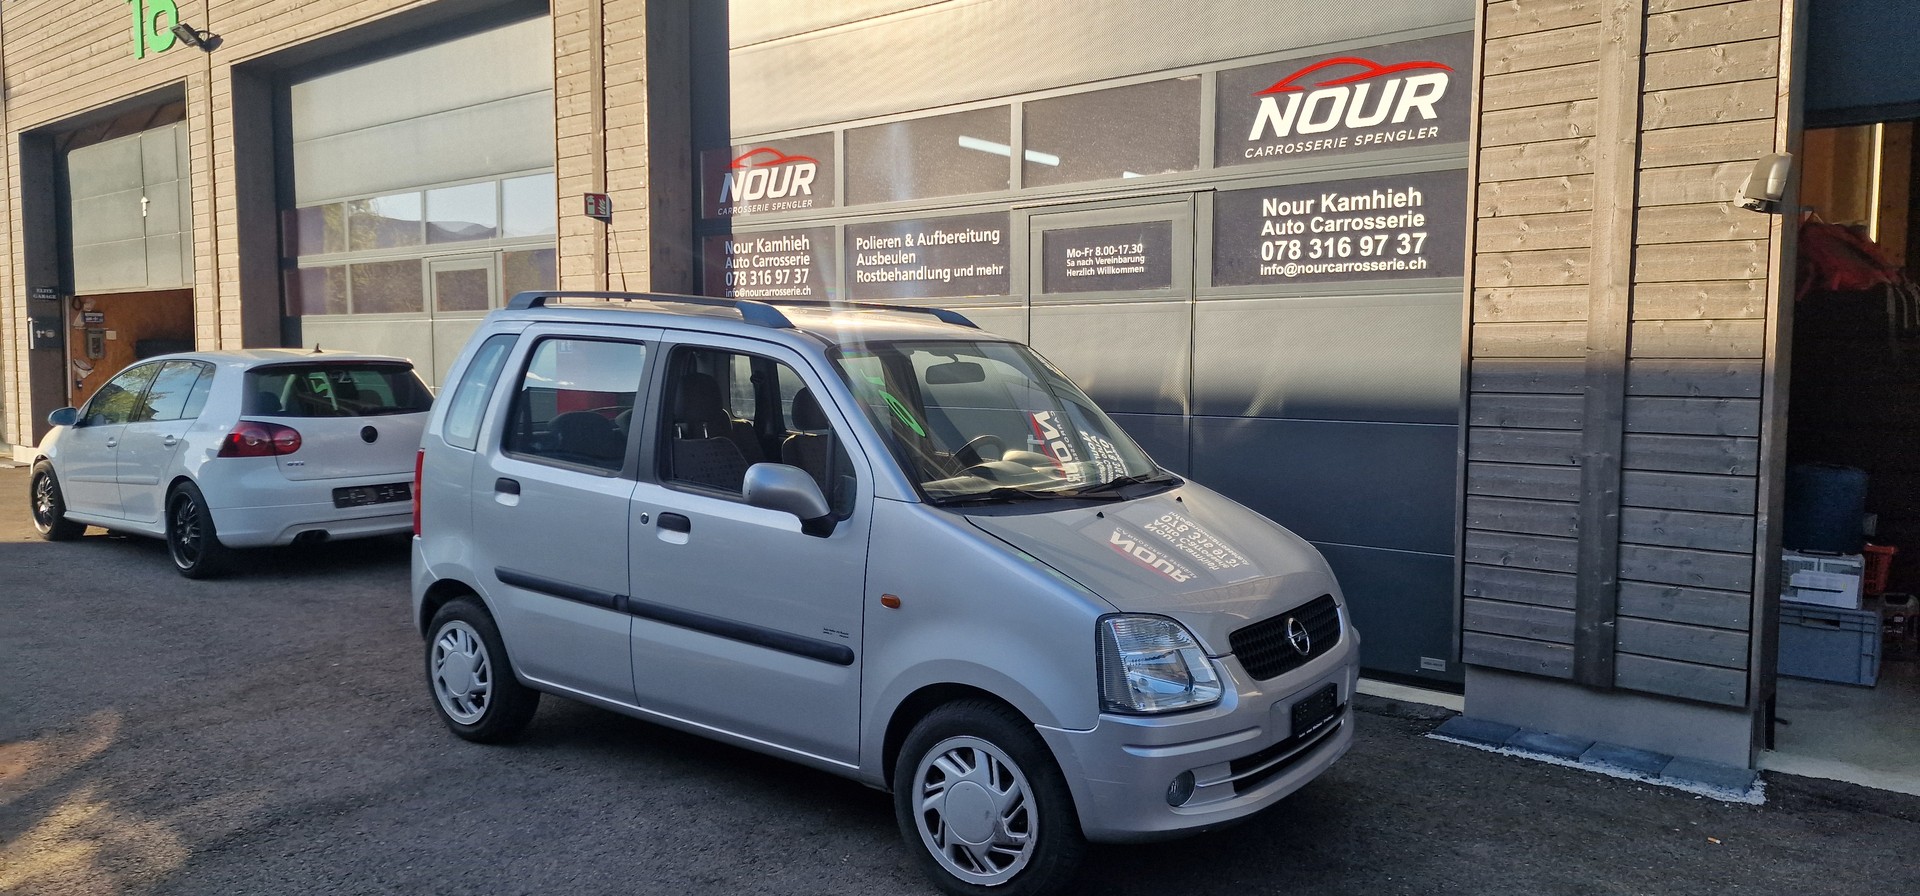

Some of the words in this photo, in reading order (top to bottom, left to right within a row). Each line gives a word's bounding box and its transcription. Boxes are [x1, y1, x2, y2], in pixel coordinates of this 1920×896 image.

[1248, 72, 1449, 141] NOUR
[1244, 136, 1348, 159] CARROSSERIE
[1354, 126, 1439, 146] SPENGLER
[719, 163, 817, 204] NOUR
[717, 203, 770, 216] CARROSSERIE
[771, 200, 813, 211] SPENGLER
[1262, 197, 1315, 217] Nour
[1320, 187, 1422, 213] Kamhieh
[1261, 220, 1304, 236] Auto
[1310, 210, 1425, 234] Carrosserie
[725, 240, 754, 255] Nour
[756, 234, 810, 253] Kamhieh
[856, 236, 902, 250] Polieren
[904, 233, 914, 247] &
[917, 228, 1000, 246] Aufbereitung
[1261, 239, 1301, 262] 078
[1308, 236, 1351, 259] 316
[1359, 234, 1389, 257] 97
[1396, 232, 1427, 255] 37
[725, 256, 750, 269] Auto
[752, 252, 811, 268] Carrosserie
[856, 250, 916, 266] Ausbeulen
[1066, 247, 1094, 259] Mo-Fr
[1095, 243, 1143, 257] 8.00-17.30
[1066, 258, 1075, 267] Sa
[1076, 257, 1094, 267] nach
[1095, 255, 1145, 266] Vereinbarung
[1260, 257, 1427, 277] info@nourcarrosserie.ch
[725, 270, 747, 286] 078
[749, 269, 772, 286] 316
[775, 269, 791, 285] 97
[793, 268, 809, 284] 37
[856, 266, 951, 283] Rostbehandlung
[953, 265, 974, 277] und
[976, 264, 1004, 276] mehr
[1066, 267, 1095, 277] Herzlich
[1097, 265, 1144, 275] Willkommen
[725, 285, 812, 298] info@nourcarrosserie.ch
